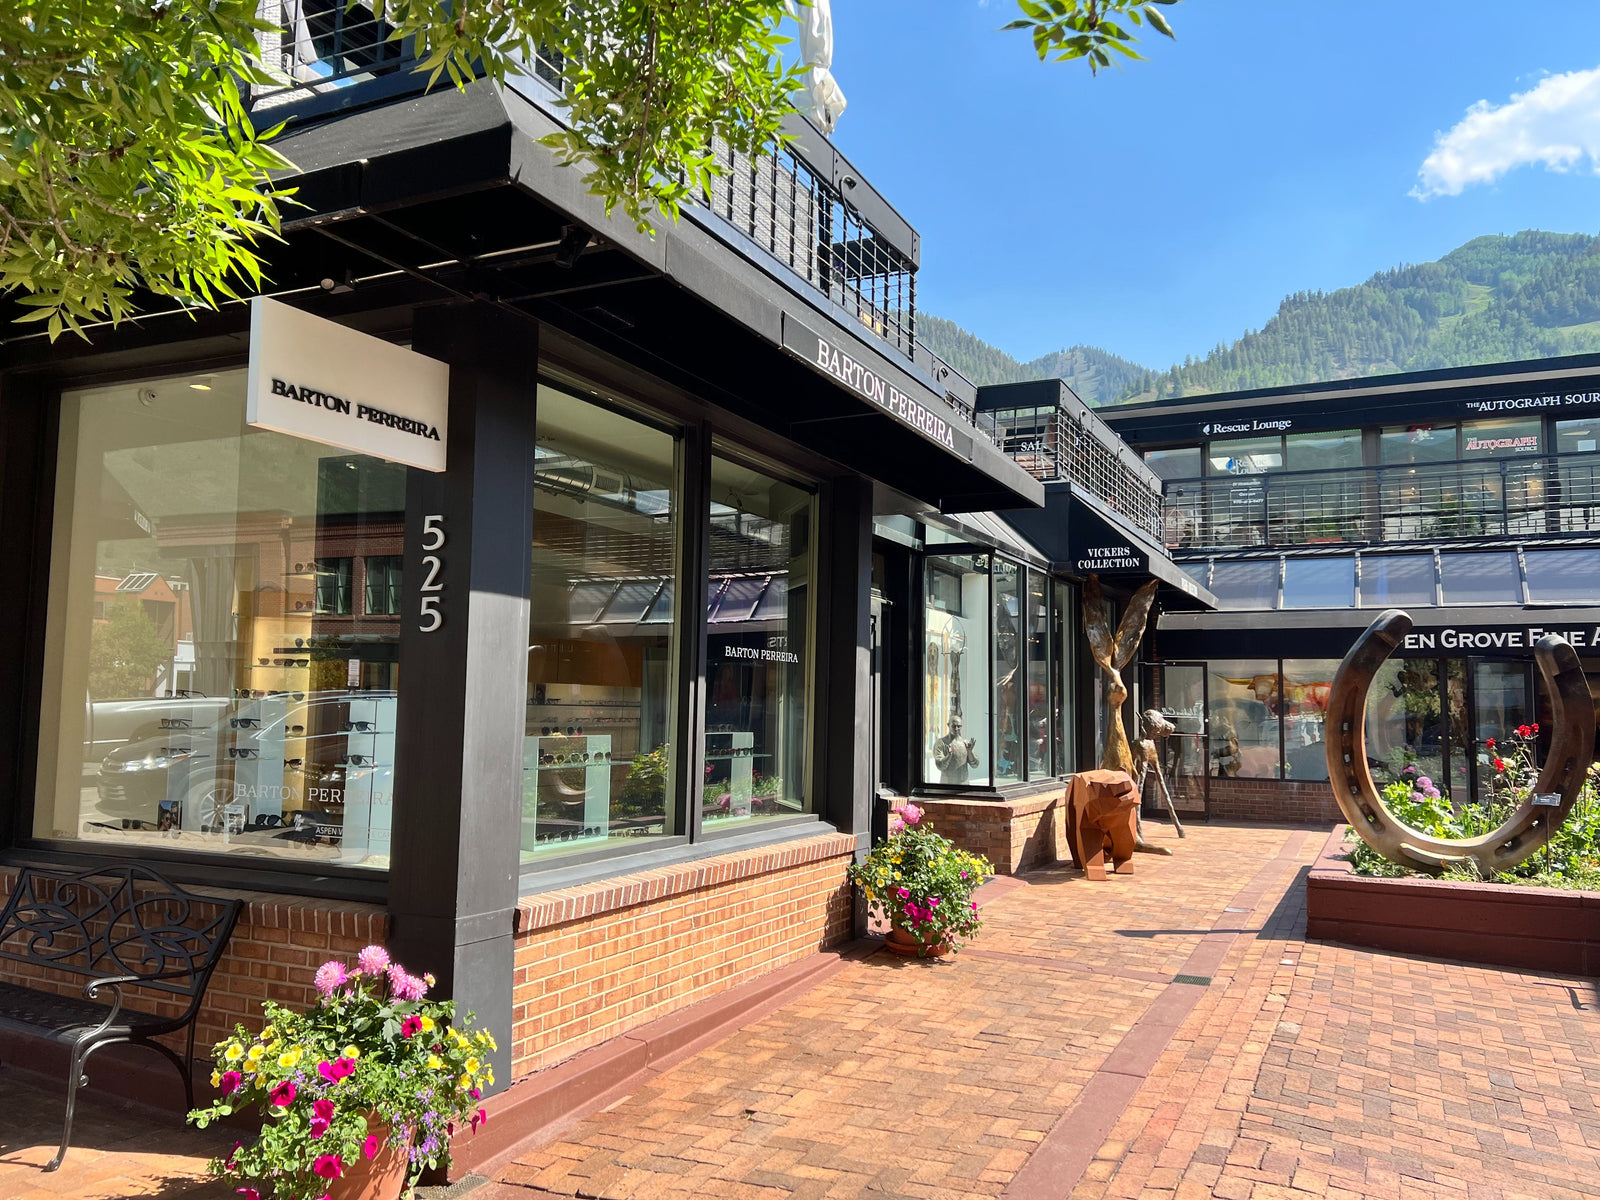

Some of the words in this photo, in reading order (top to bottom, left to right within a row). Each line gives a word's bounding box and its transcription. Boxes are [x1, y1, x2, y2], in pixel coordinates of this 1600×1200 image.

[817, 338, 885, 404] BARTON
[889, 386, 955, 448] PERREIRA
[271, 378, 351, 415] BARTON
[357, 403, 441, 441] PERREIRA
[1478, 395, 1561, 412] AUTOGRAPH
[1213, 423, 1250, 434] Rescue
[1253, 419, 1292, 431] Lounge
[1465, 436, 1538, 451] AUTOGRAPH
[1088, 547, 1130, 558] VICKERS
[1078, 557, 1140, 570] COLLECTION
[419, 515, 446, 632] 525
[1440, 629, 1524, 649] GROVE
[725, 645, 759, 659] BARTON
[760, 649, 799, 663] PERREIRA
[236, 783, 301, 800] BARTON
[315, 826, 338, 836] ASPEN
